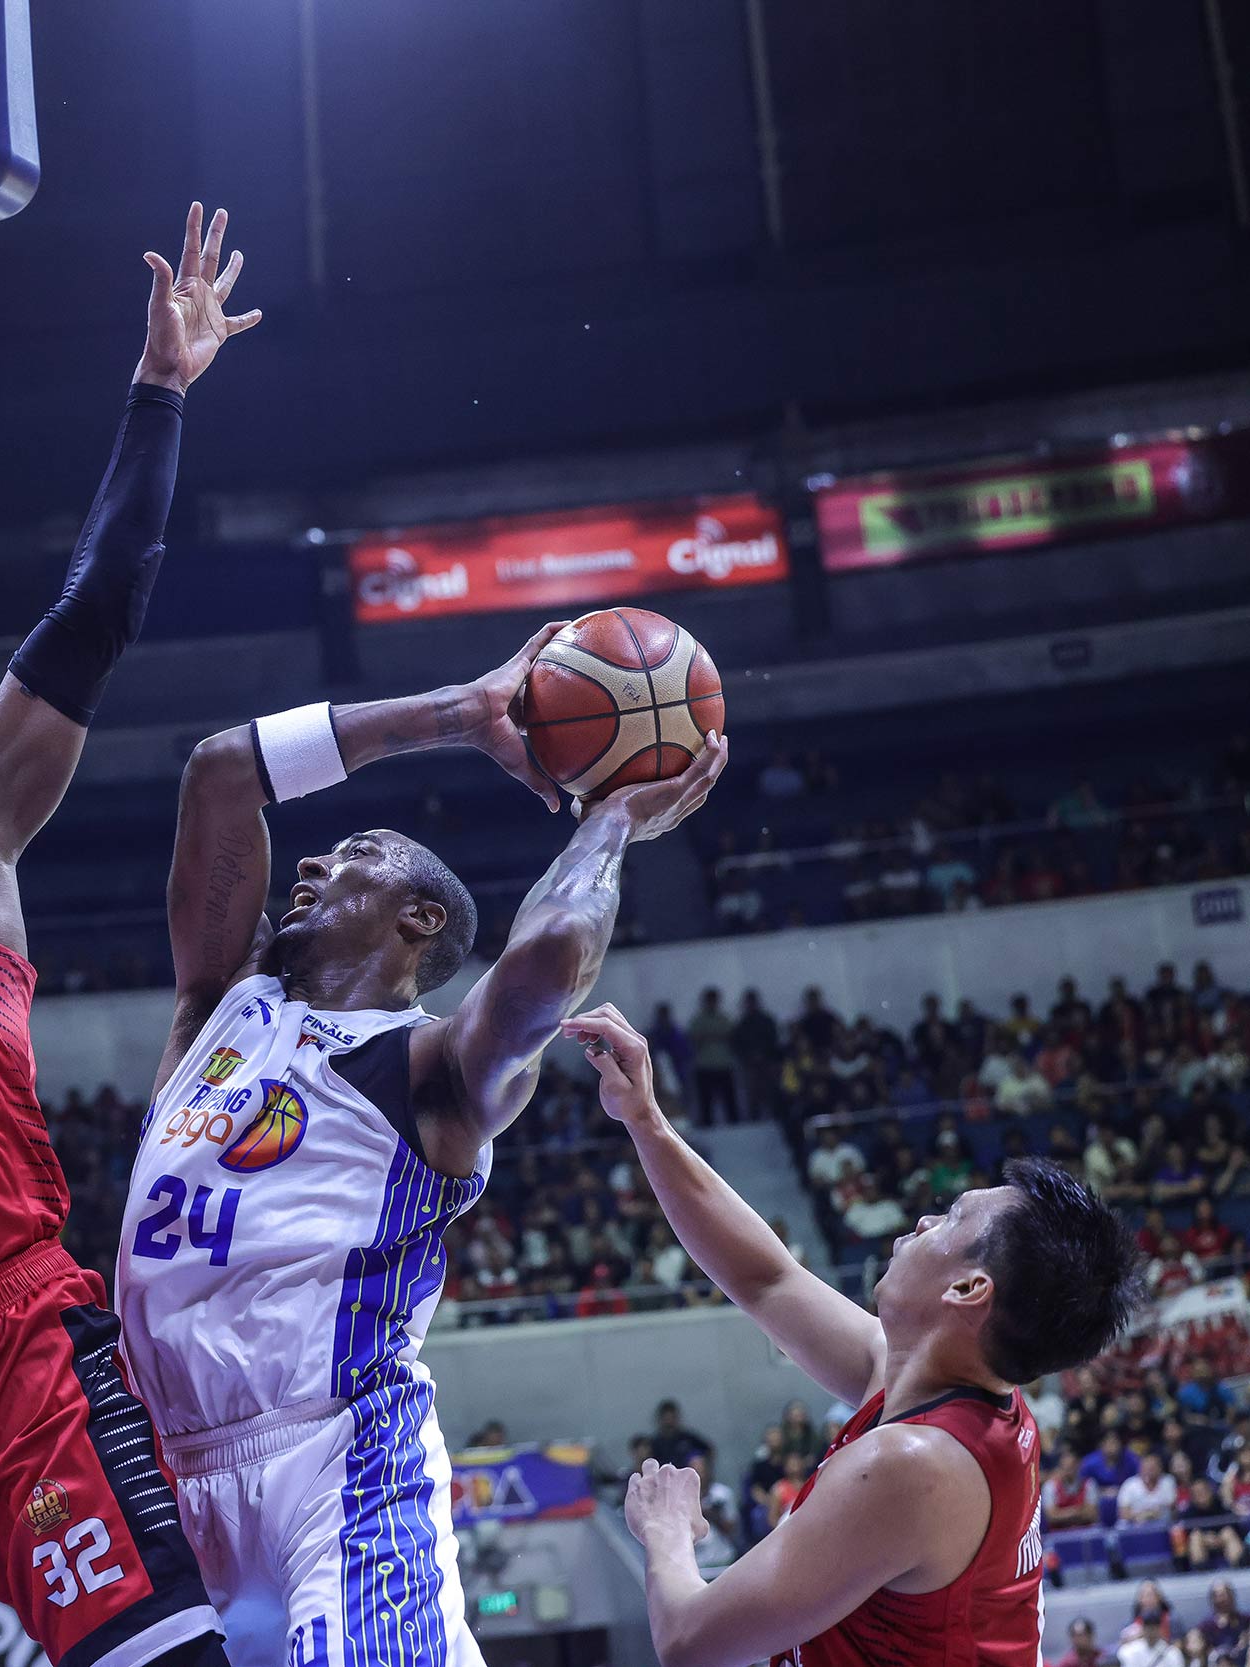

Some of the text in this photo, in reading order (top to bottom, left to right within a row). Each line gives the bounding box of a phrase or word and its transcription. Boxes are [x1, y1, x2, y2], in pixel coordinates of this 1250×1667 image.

[301, 1013, 359, 1047] FINALS
[183, 1084, 253, 1114] ROPANG
[131, 1174, 243, 1268] 24
[26, 1490, 60, 1518] 190
[30, 1504, 63, 1525] YEARS
[31, 1516, 126, 1609] 32
